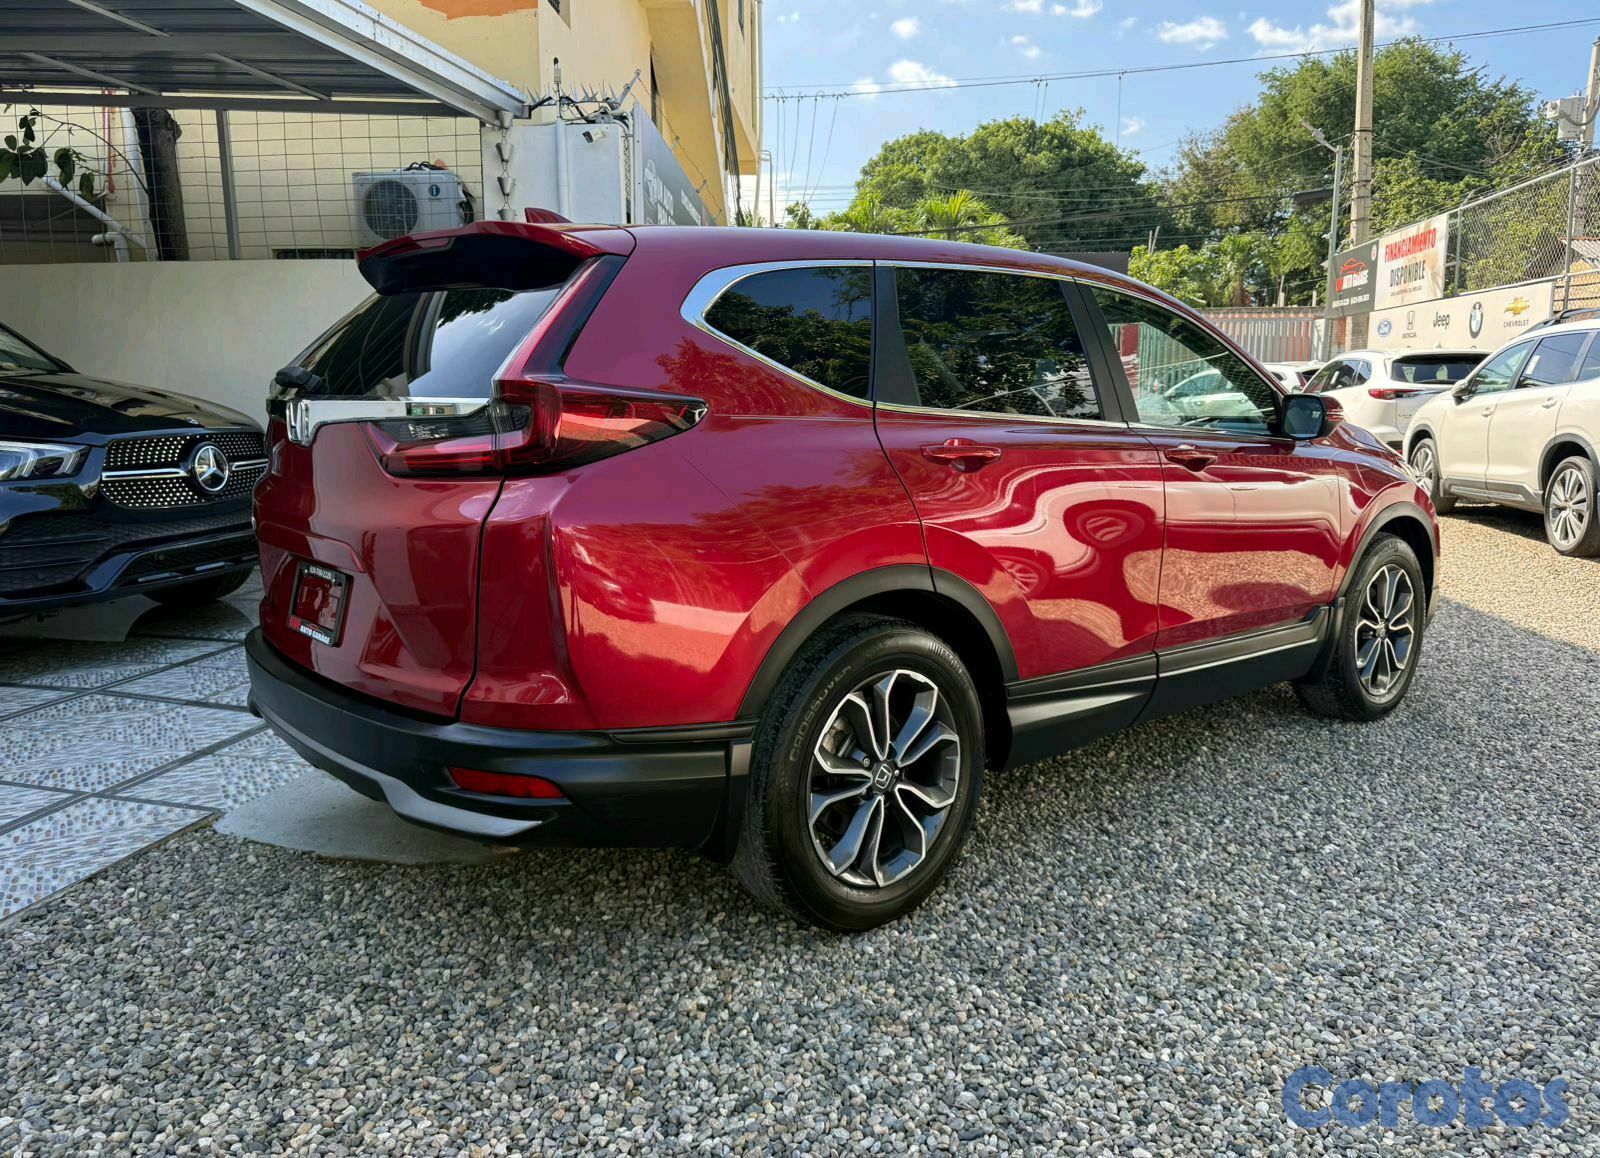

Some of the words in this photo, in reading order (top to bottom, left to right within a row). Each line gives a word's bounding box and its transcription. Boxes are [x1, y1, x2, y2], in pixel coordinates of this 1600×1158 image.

[1385, 228, 1437, 262] FINANCIAMIENTO
[1390, 260, 1426, 287] DISPONIBLE
[1432, 312, 1451, 330] Jeep
[1503, 319, 1530, 329] CHEVROLET
